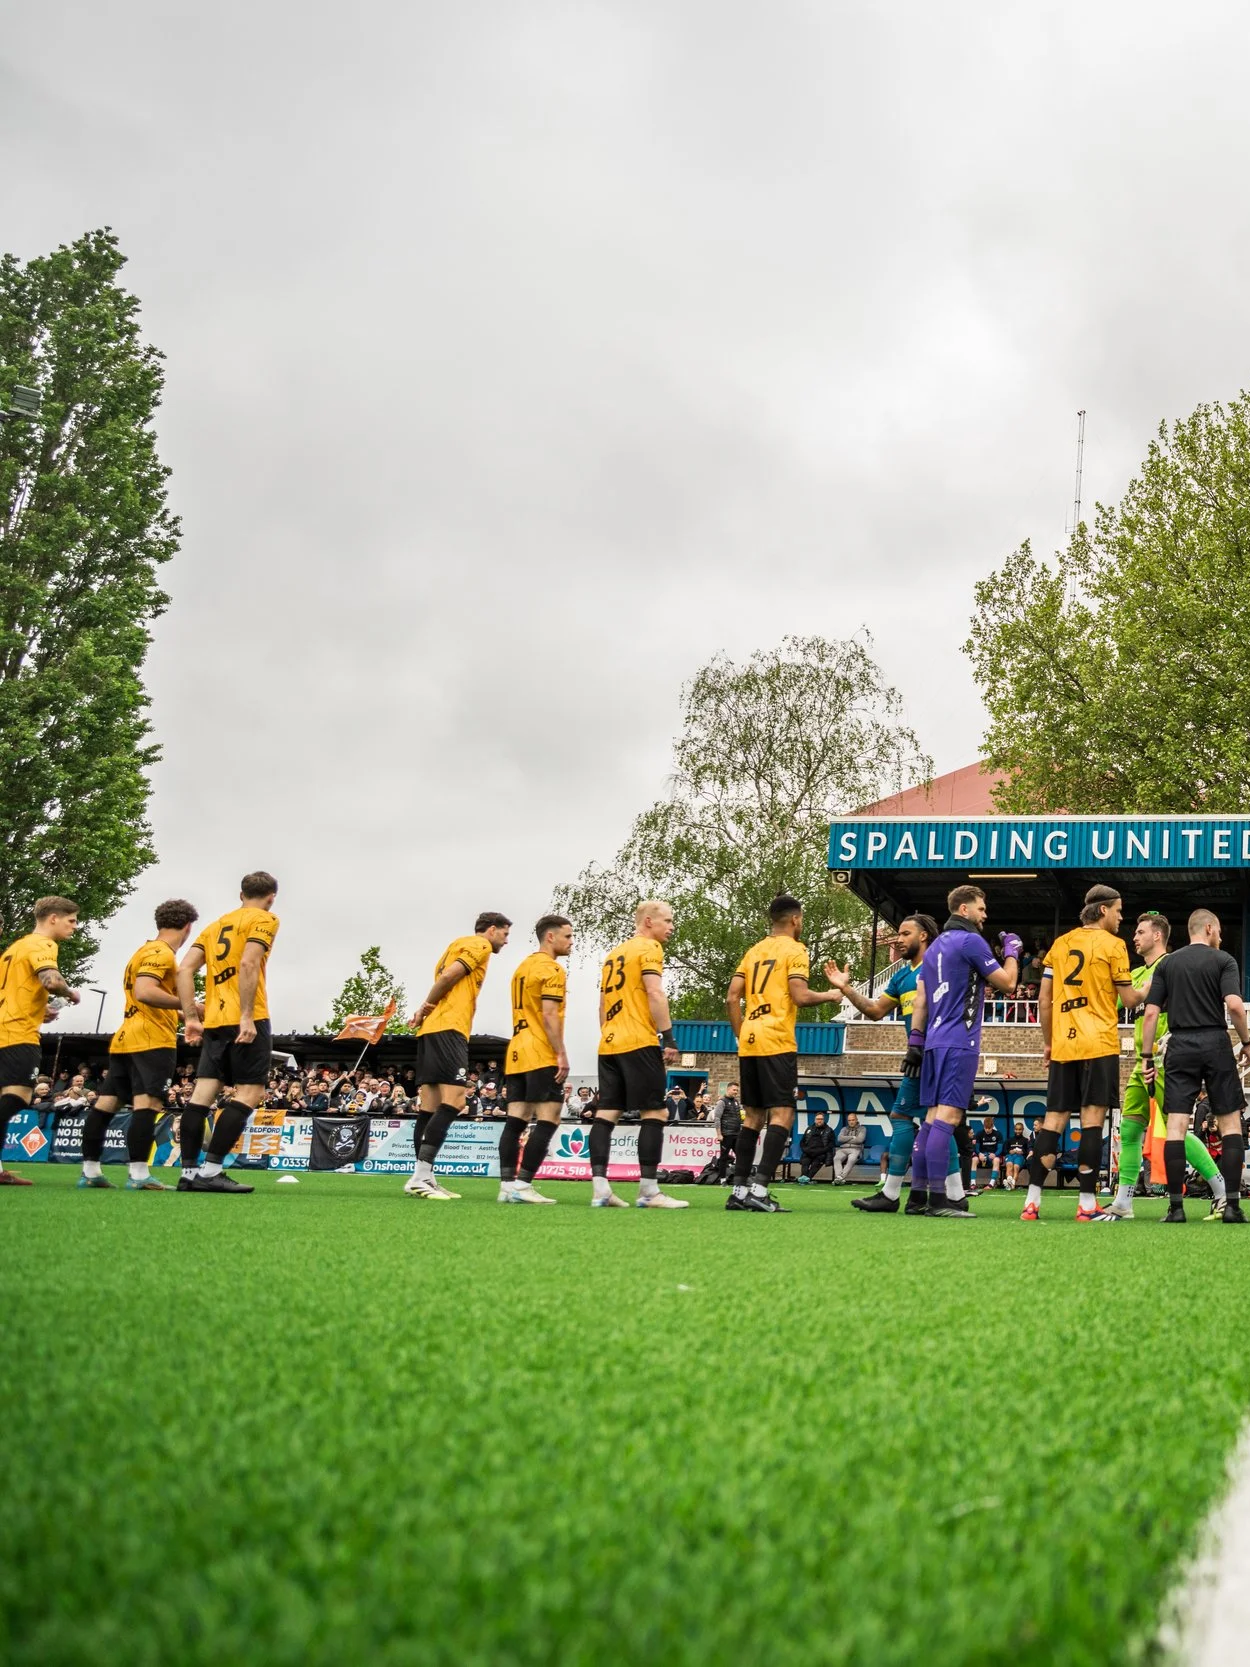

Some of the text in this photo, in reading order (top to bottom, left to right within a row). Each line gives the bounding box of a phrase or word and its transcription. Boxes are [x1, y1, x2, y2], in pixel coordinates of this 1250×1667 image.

[839, 829, 1068, 861] SPALDING
[216, 925, 234, 961] 5
[605, 955, 626, 994] 23
[751, 959, 777, 995] 17
[937, 952, 943, 983] 1
[1063, 949, 1085, 987] 2
[514, 976, 526, 1010] 11
[57, 1128, 71, 1137] NO
[59, 1118, 73, 1127] NO
[469, 1123, 494, 1131] Services
[54, 1138, 69, 1147] NO
[368, 1130, 389, 1140] oup
[669, 1134, 721, 1146] Message
[674, 1148, 688, 1157] us
[691, 1148, 704, 1157] to
